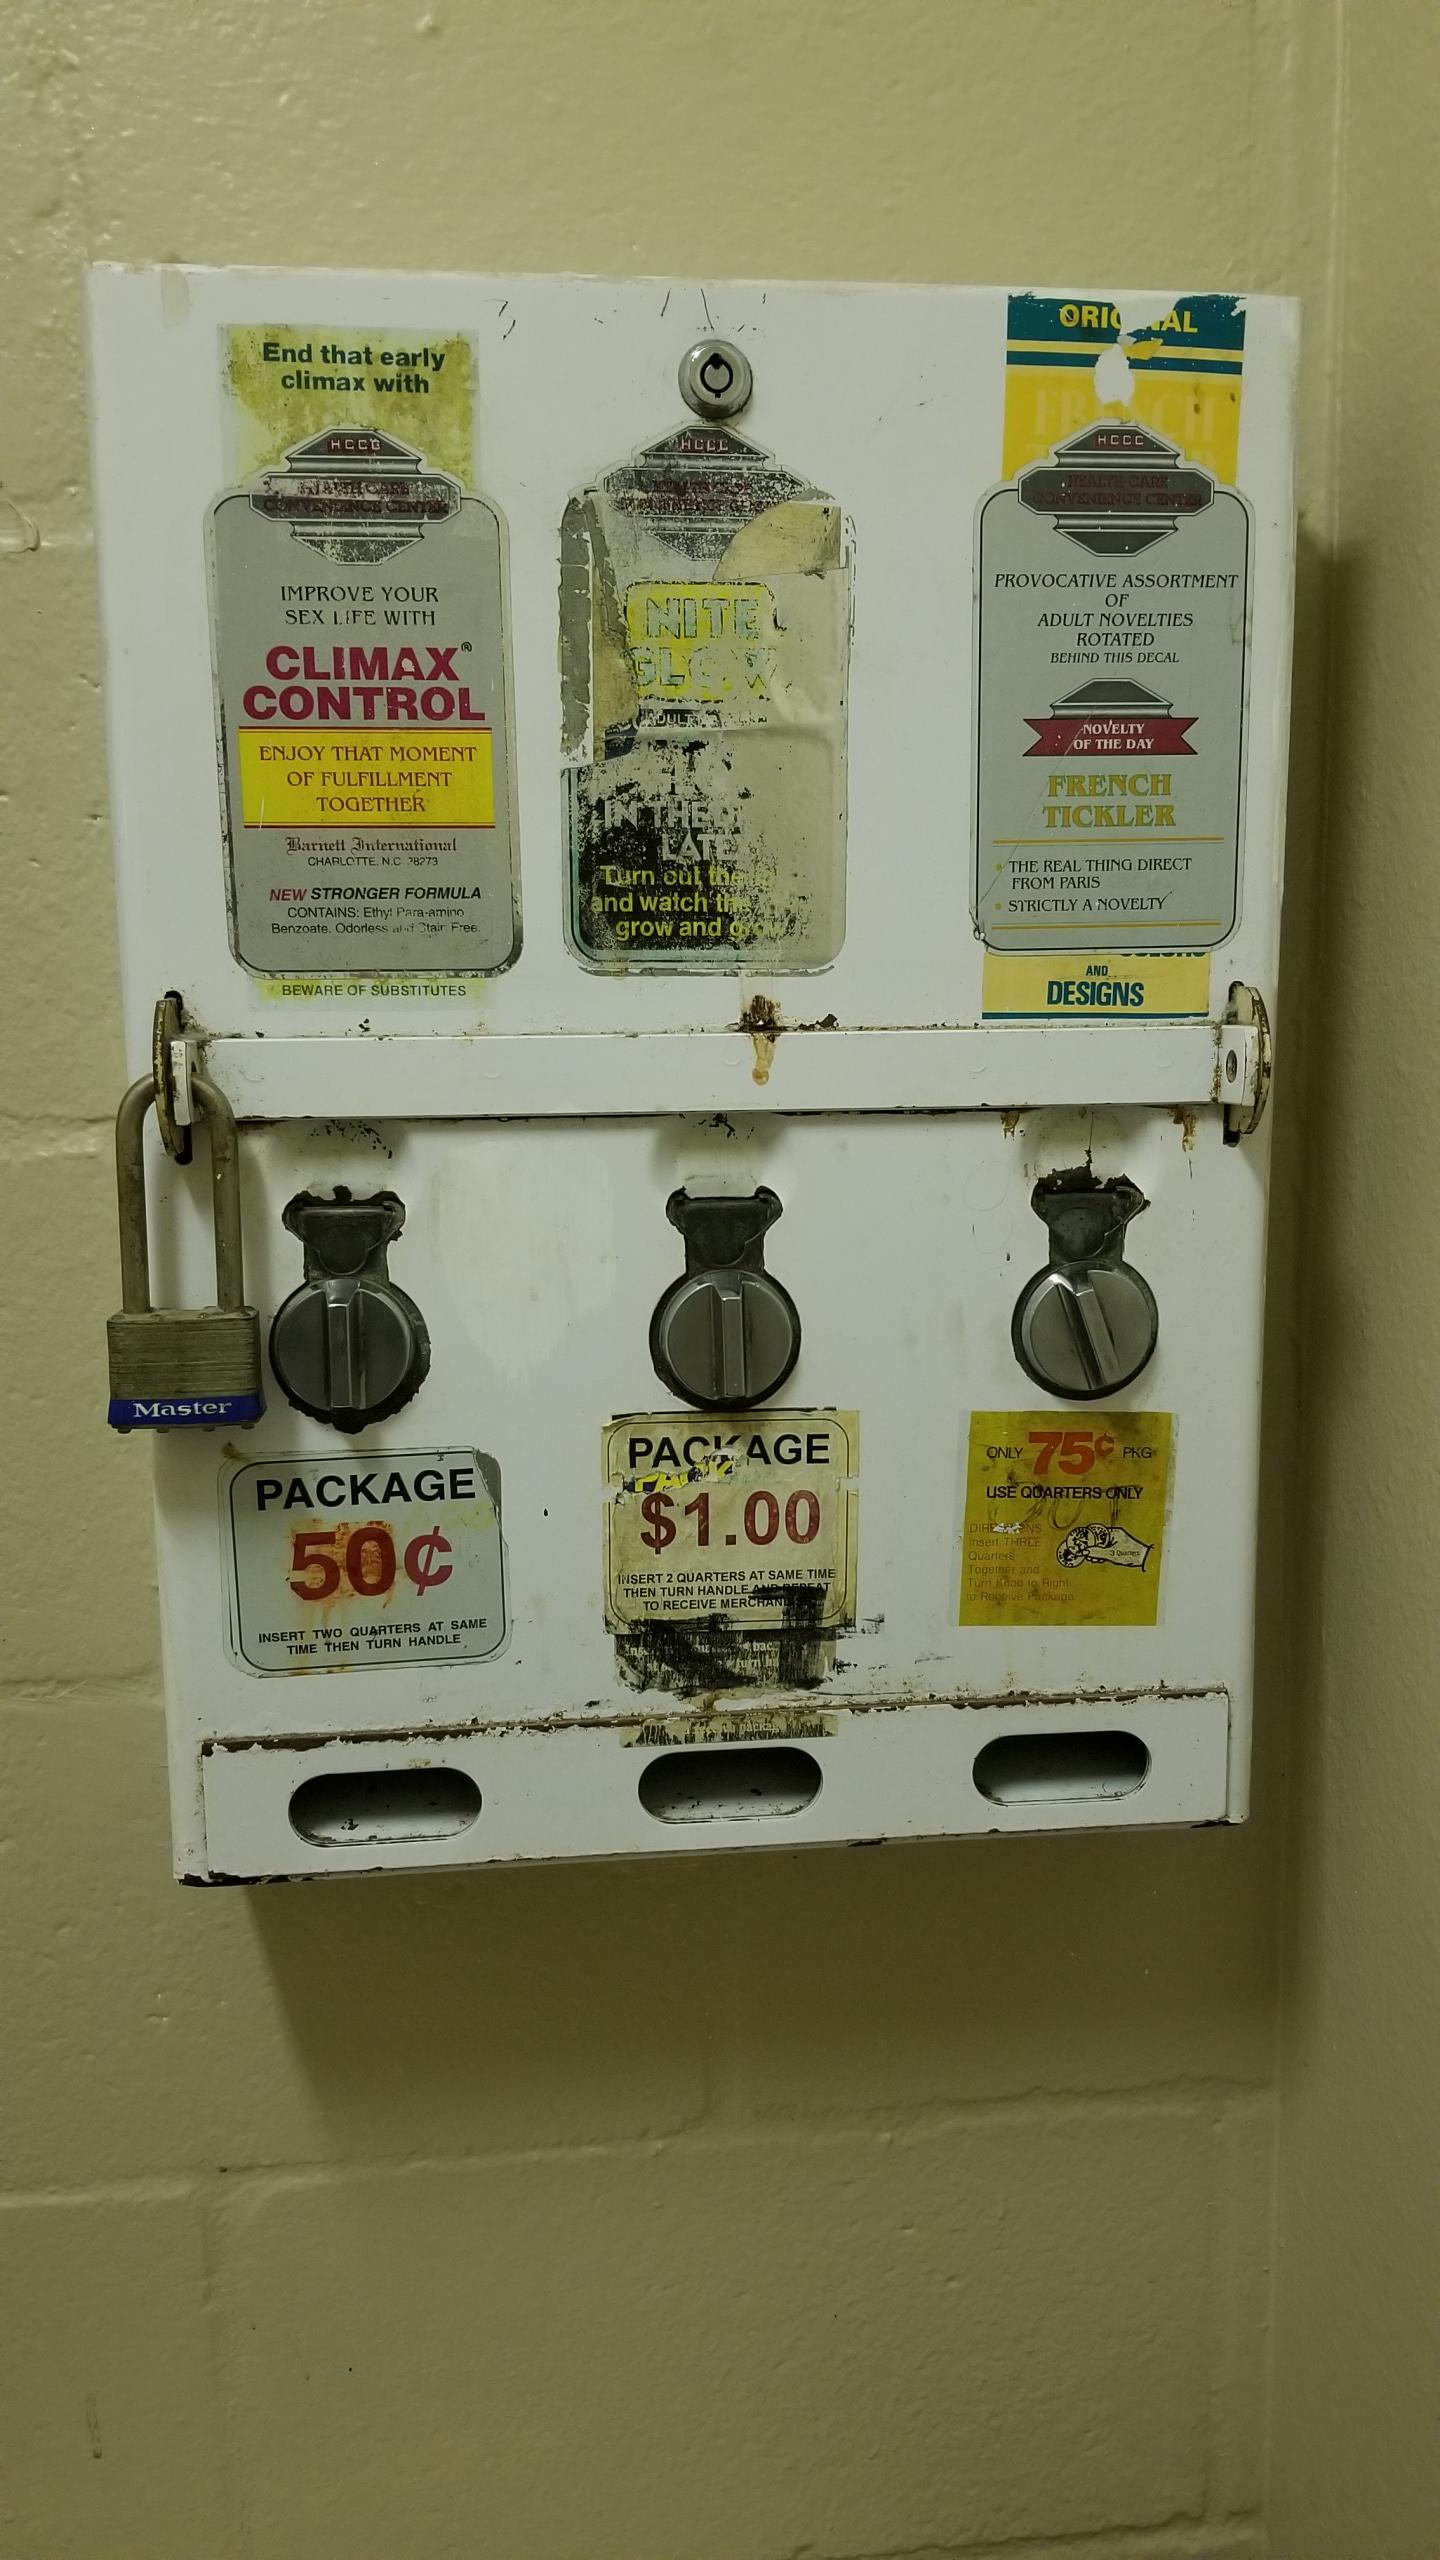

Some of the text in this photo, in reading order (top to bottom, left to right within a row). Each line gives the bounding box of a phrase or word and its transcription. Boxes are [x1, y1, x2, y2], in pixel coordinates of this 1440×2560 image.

[1060, 304, 1198, 333] ORIAL
[263, 342, 445, 373] End that early
[281, 370, 429, 394] climax with
[1097, 434, 1144, 446] HCCC
[994, 573, 1239, 589] PROVOCATIVE ASSORTMENT
[281, 586, 439, 603] IMPROVE YOUR
[1105, 593, 1130, 607] OF
[285, 610, 324, 625] SEX
[384, 610, 435, 626] WITH
[646, 597, 760, 640] NITE
[1038, 613, 1193, 627] ADULT NOVELTIES
[1076, 632, 1154, 647] ROTATED
[1050, 652, 1179, 663] BEHIND THIS DECAL
[242, 685, 486, 721] CONTROL
[1083, 723, 1145, 735] NOVELTY
[1073, 738, 1154, 750] OF THE DAY
[259, 745, 477, 762] ENJOY THAT MOMENT
[286, 771, 453, 787] OF FULFILLMENT
[1048, 774, 1172, 798] FRENCH
[316, 796, 426, 812] TOGETHER
[1042, 804, 1177, 828] TICKLER
[285, 836, 457, 856] Barnett International
[1008, 857, 1192, 873] THE REAL THING DIRECT
[600, 865, 655, 887] Turn
[664, 866, 702, 886] out
[1012, 876, 1101, 890] FROM PARIS
[269, 886, 482, 901] NEW STRONGER FORMULA
[591, 893, 633, 912] and
[639, 893, 708, 913] watch
[1008, 897, 1165, 912] STRICTLY A NOVELTY
[287, 907, 359, 918] CONTAINS:
[335, 923, 388, 934] Odorless
[615, 918, 674, 941] grow
[679, 918, 722, 937] and
[1086, 965, 1109, 976] AND
[282, 985, 467, 997] BEWARE OF SUBSTITUTES
[1047, 981, 1144, 1007] DESIGNS
[133, 1402, 232, 1418] Master
[986, 1447, 1023, 1459] ONLY
[256, 1468, 476, 1511] PACKAGE
[986, 1486, 1143, 1500] USE QUARTERS ONLY
[640, 1489, 821, 1555] $1.00
[970, 1523, 1042, 1533] DIREONS
[290, 1525, 453, 1601] 50¢
[618, 1568, 836, 1586] INSERT 2 QUARTERS AT SAME TIME
[623, 1587, 656, 1598] THEN
[660, 1586, 694, 1597] TURN
[697, 1584, 749, 1596] HANDLE
[643, 1600, 660, 1611] TO
[663, 1599, 717, 1611] RECEIVE
[258, 1618, 487, 1643] INSERT TWO QUARTERS AT SAME
[287, 1634, 461, 1655] TIME THEN TURN HANDLE
